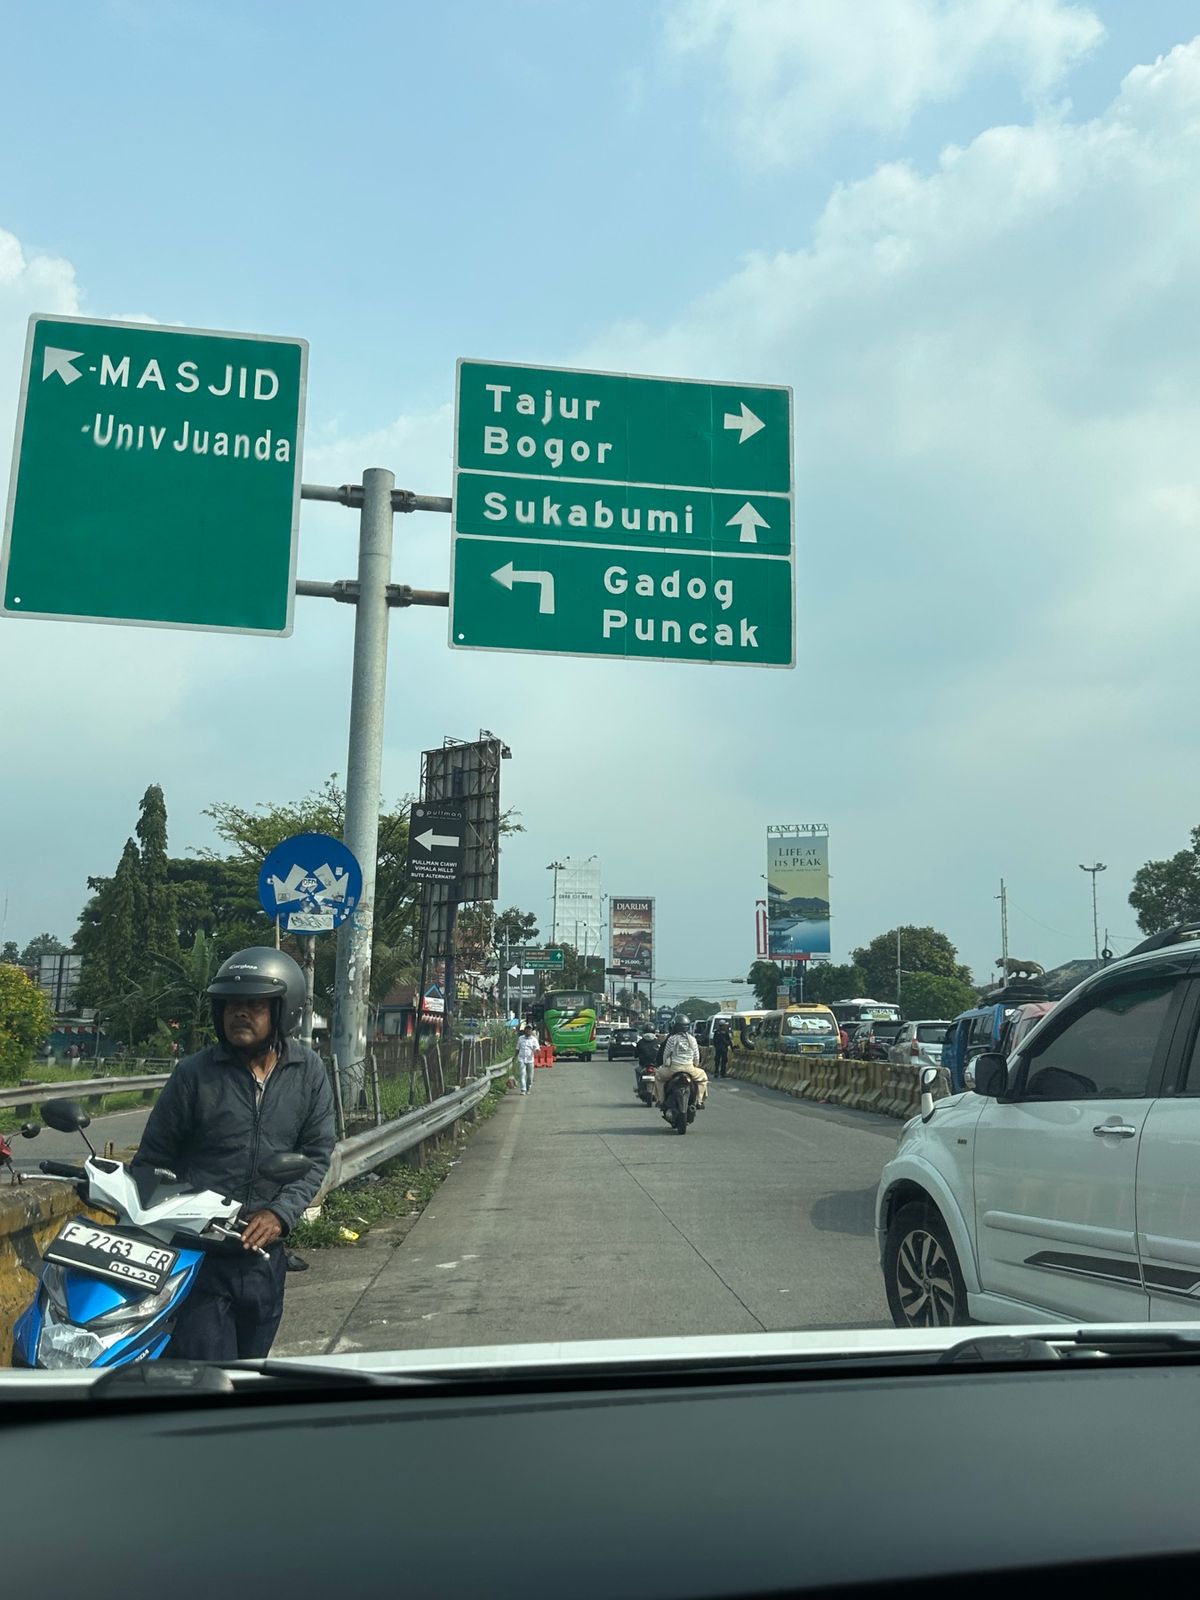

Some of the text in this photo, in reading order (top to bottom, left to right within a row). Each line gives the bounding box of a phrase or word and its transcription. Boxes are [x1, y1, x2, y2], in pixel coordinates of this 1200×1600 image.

[485, 384, 600, 425] Tajur
[173, 421, 291, 462] Juanda
[483, 426, 612, 468] Bogor
[483, 491, 694, 534] Sukabumi
[603, 566, 733, 610] Gadog
[602, 609, 759, 648] Puncak
[767, 824, 829, 833] RANCAMAYA
[412, 859, 439, 867] PULLMAN
[64, 1226, 80, 1240] F
[87, 1233, 133, 1258] 2263
